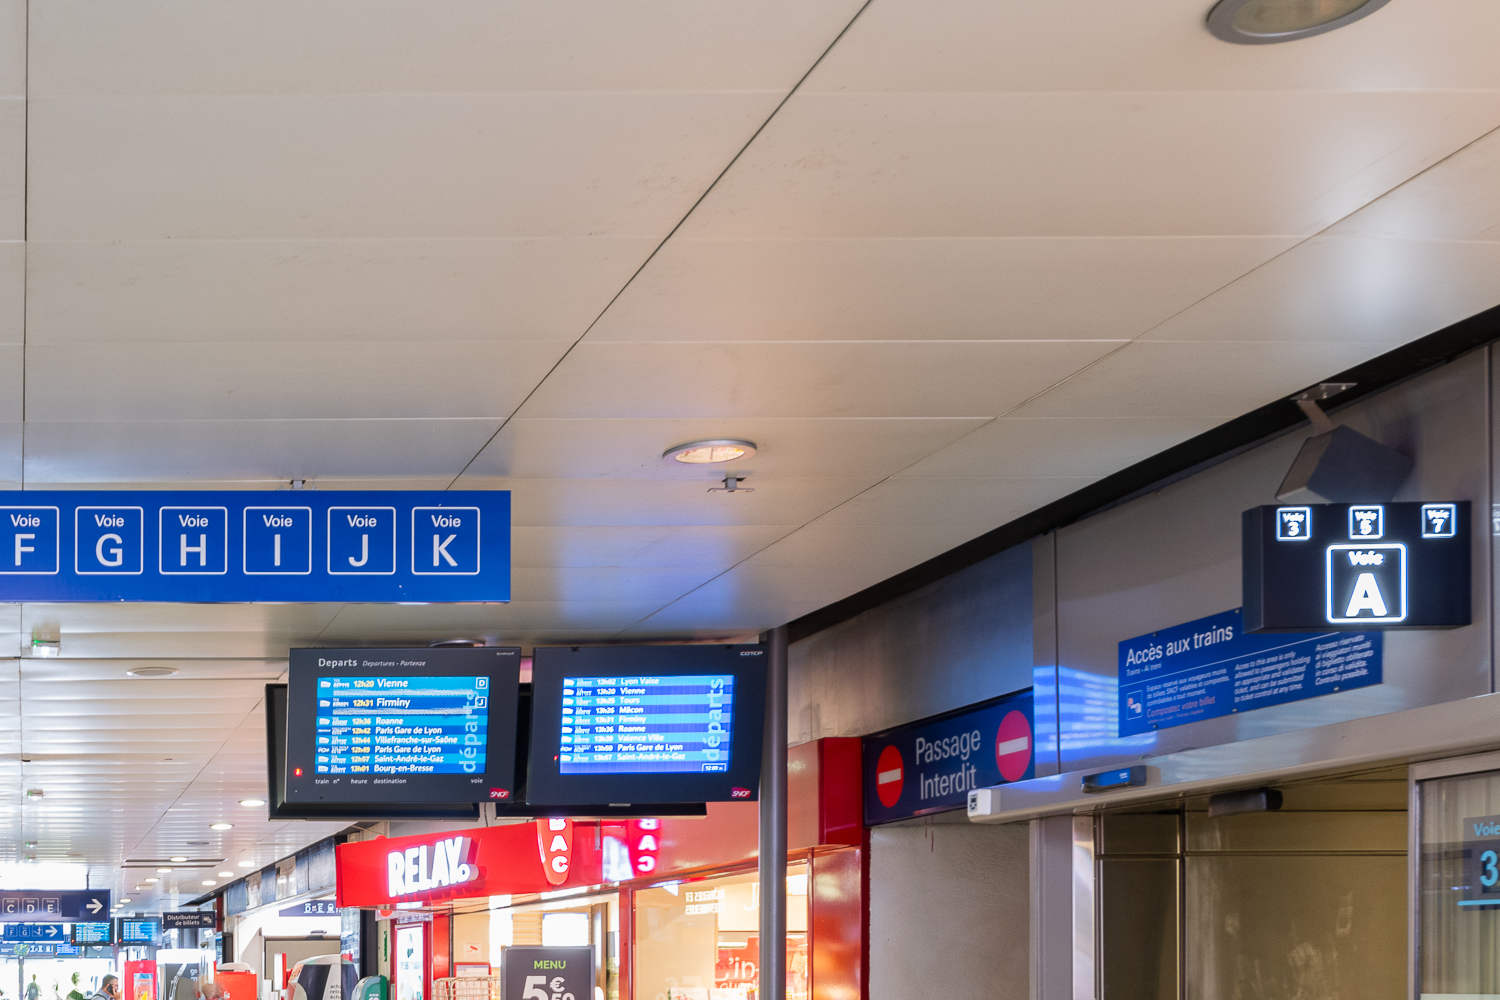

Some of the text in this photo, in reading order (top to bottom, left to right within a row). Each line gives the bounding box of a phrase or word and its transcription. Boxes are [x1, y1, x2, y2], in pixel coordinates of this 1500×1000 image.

[11, 515, 40, 526] Voie
[95, 515, 124, 527] Voie
[179, 515, 208, 527] Voie
[263, 515, 292, 527] Voie
[347, 515, 377, 527] Voie
[431, 515, 461, 527] Voie
[1432, 518, 1445, 533] 7
[1287, 521, 1300, 536] 3
[1359, 519, 1373, 535] 5
[15, 534, 35, 566] F
[96, 534, 122, 566] G
[181, 534, 206, 566] H
[275, 534, 280, 566] I
[349, 534, 368, 566] J
[433, 535, 458, 566] K
[1348, 550, 1384, 566] Voie
[1345, 572, 1388, 617] A
[1125, 625, 1233, 667] Accès aux trains
[318, 658, 357, 668] Departs
[377, 679, 408, 688] Vienne
[621, 678, 638, 686] Lyon
[376, 698, 411, 709] Firminy
[619, 706, 643, 714] Mâcon
[375, 717, 404, 725] Roanne
[618, 716, 647, 725] Firminy
[702, 678, 726, 761] départs
[424, 727, 442, 736] Lyon
[618, 725, 646, 733] Roanne
[375, 736, 458, 744] Villefranche-sur-Saône
[423, 746, 441, 755] Lyon
[665, 743, 683, 752] Lyon
[916, 730, 981, 765] Passage
[374, 755, 444, 763] Saint-André-le-Gaz
[616, 753, 686, 761] Saint-André-le-Gaz
[374, 765, 434, 774] Bourg-en-Bresse
[920, 763, 977, 800] Interdit
[388, 836, 470, 897] RELAY
[1480, 850, 1499, 886] 3
[7, 904, 15, 913] C
[27, 904, 35, 913] D
[47, 904, 54, 913] E
[534, 960, 566, 969] MENU
